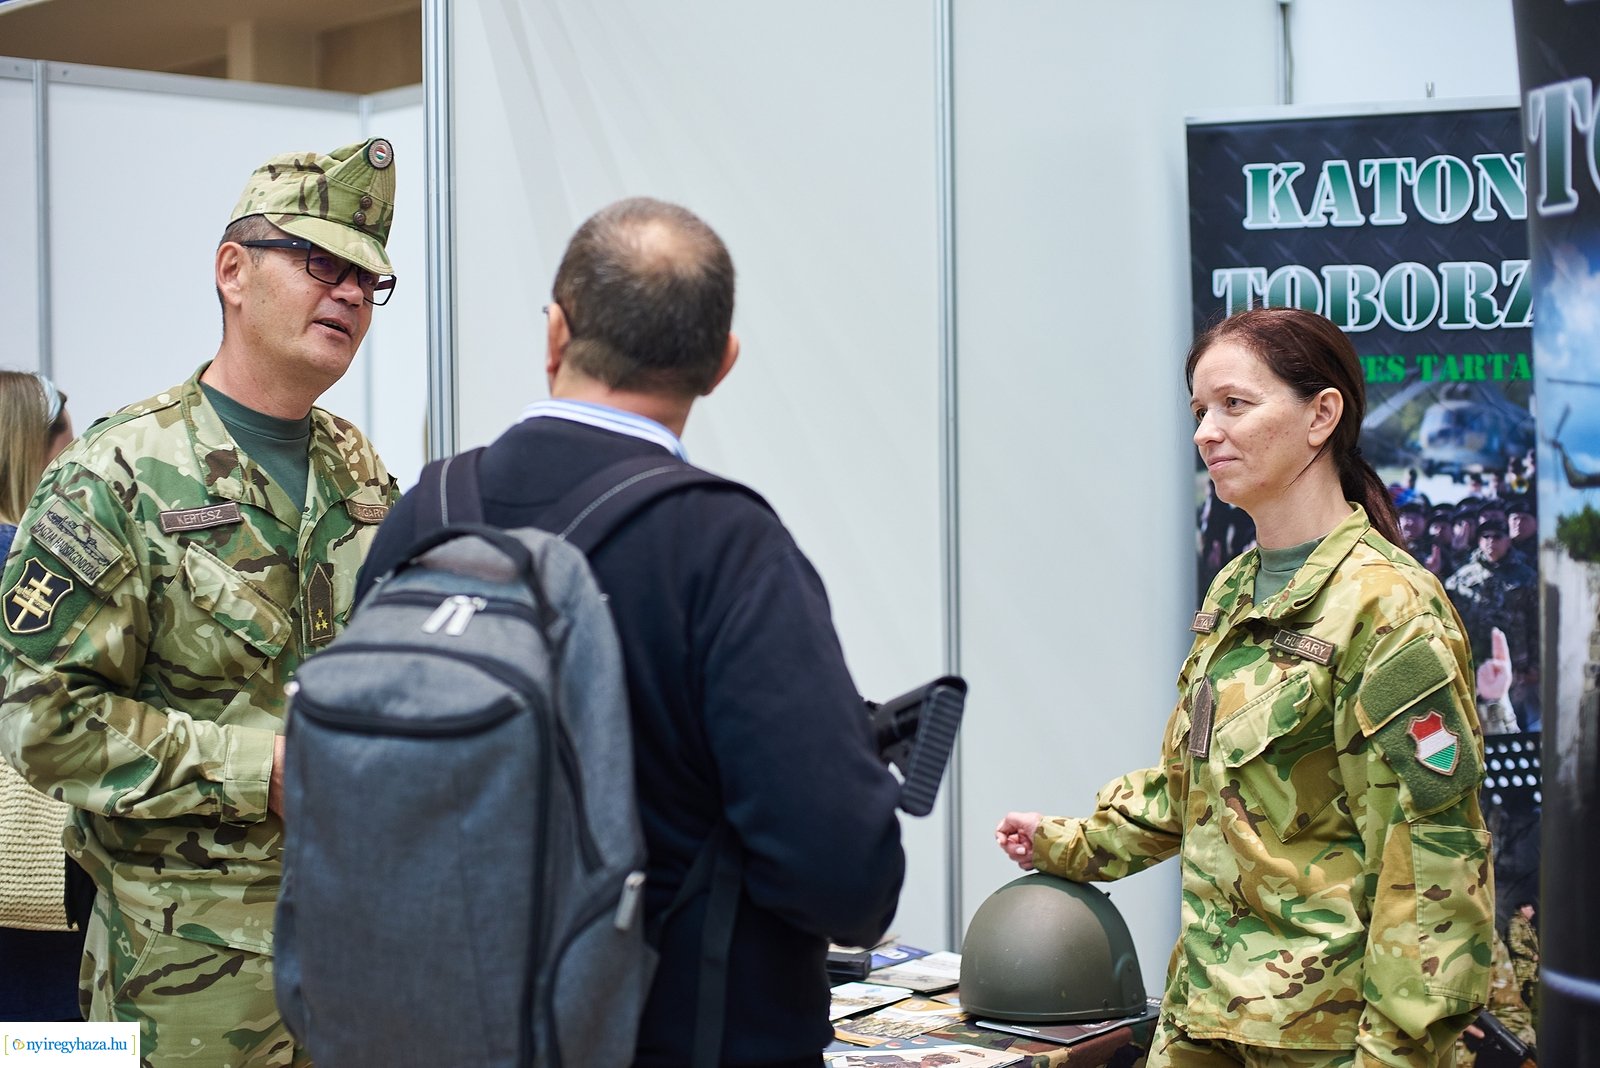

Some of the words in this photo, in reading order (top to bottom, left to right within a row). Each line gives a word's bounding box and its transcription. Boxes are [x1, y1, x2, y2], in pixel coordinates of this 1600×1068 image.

[1528, 77, 1600, 217] T
[1242, 153, 1527, 230] KATON
[1212, 259, 1534, 333] TOBORZ
[1360, 355, 1406, 384] ES
[1415, 353, 1532, 382] TARTA
